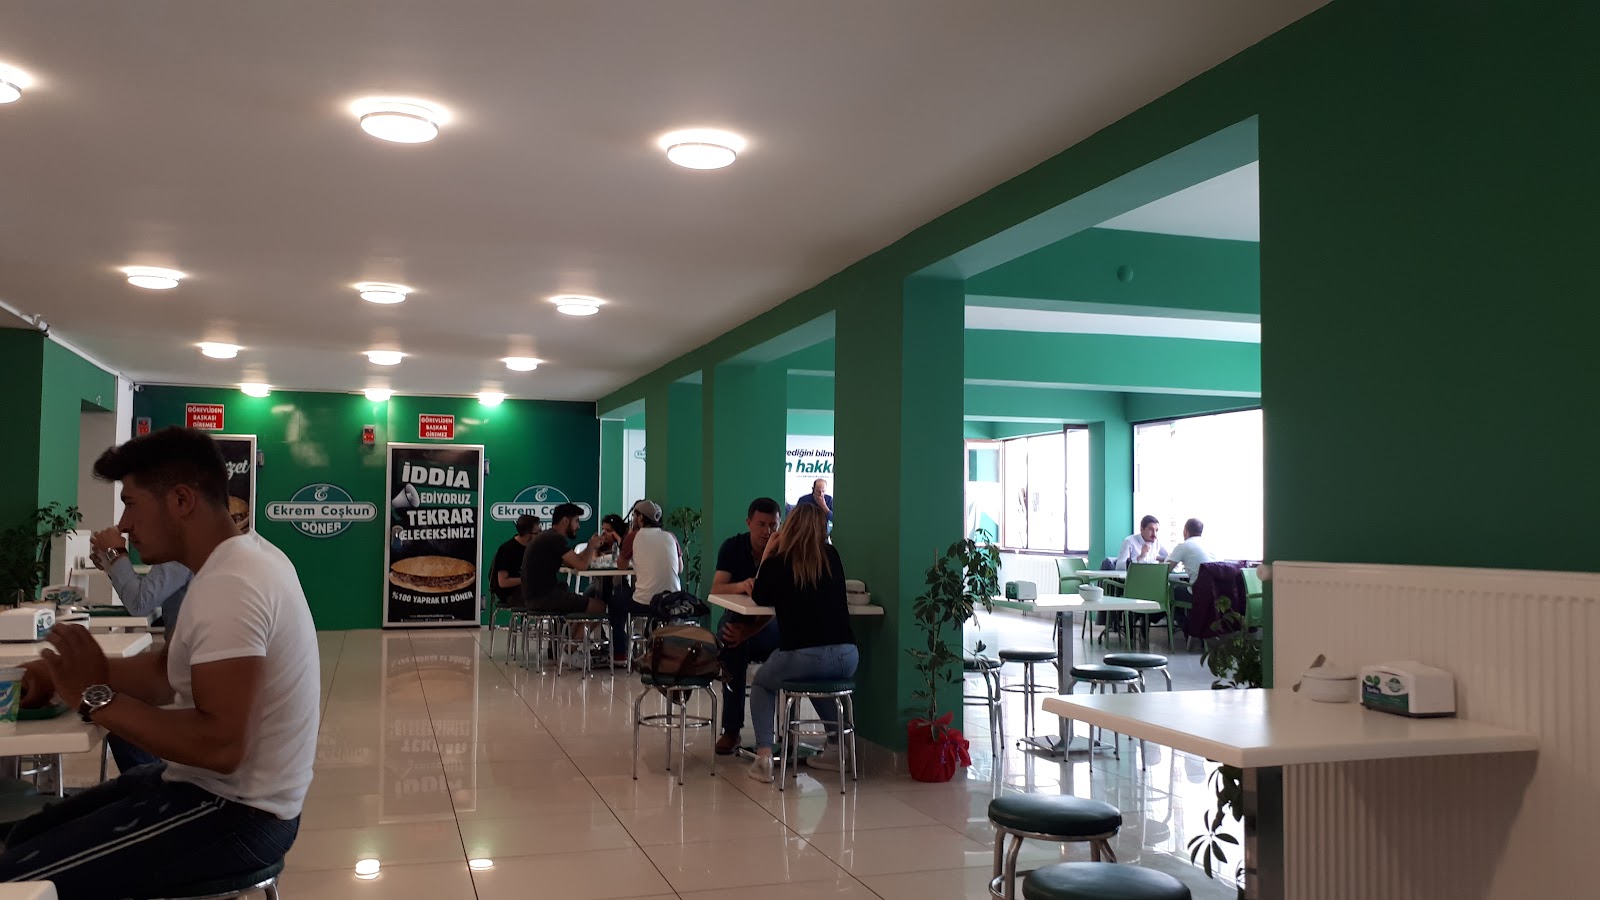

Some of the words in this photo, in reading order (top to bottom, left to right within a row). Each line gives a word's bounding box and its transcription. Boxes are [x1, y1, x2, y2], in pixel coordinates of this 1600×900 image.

[786, 449, 814, 458] ediğini
[226, 459, 251, 480] zet
[402, 462, 470, 488] İDDİA
[420, 491, 471, 504] EDİYORUZ
[273, 505, 315, 516] Ekrem
[321, 505, 369, 518] Coşkun
[406, 508, 474, 526] TEKRAR
[498, 506, 536, 516] Ekrem
[301, 520, 342, 534] DÖNER
[400, 526, 475, 540] ELECEKSİNİZ!
[392, 591, 411, 602] %100
[413, 595, 440, 604] YAPRAK
[441, 596, 449, 604] ET
[450, 591, 473, 602] DÖNER
